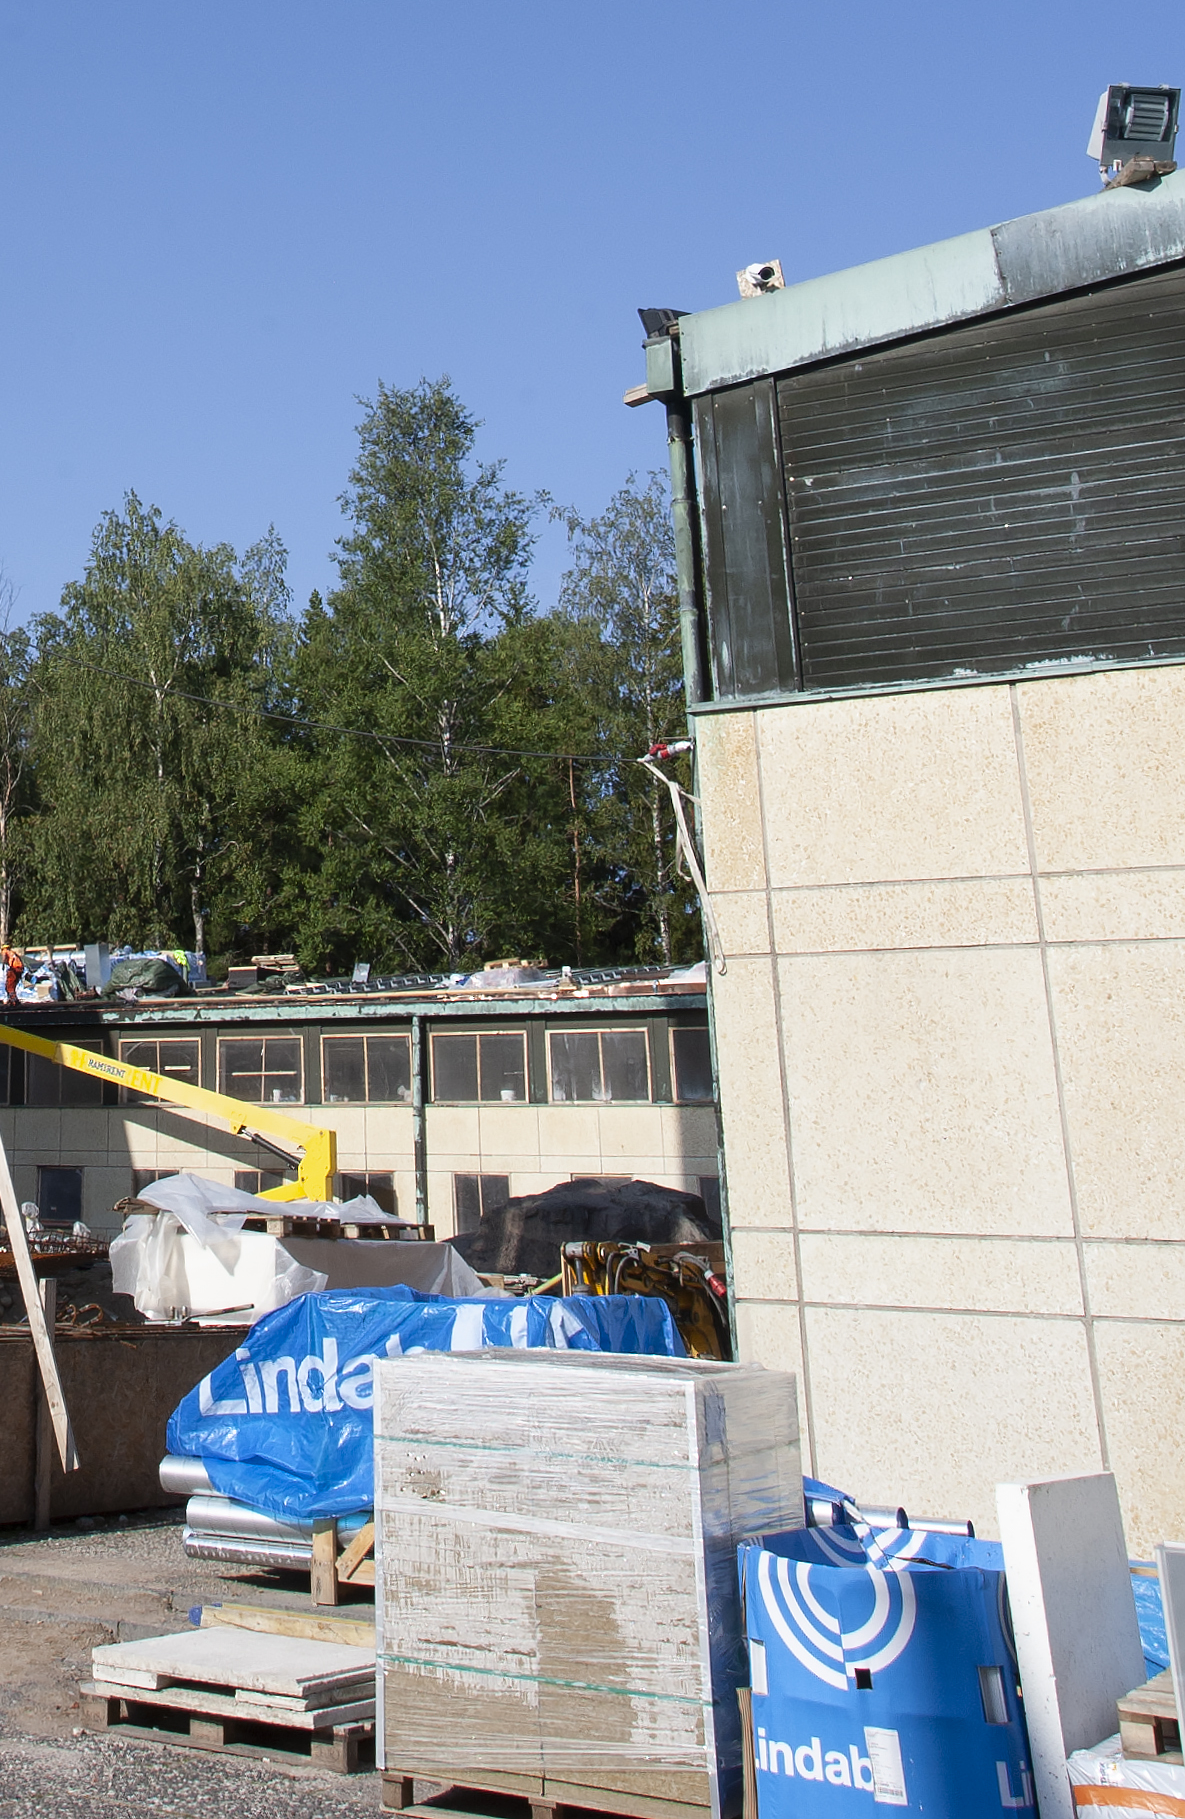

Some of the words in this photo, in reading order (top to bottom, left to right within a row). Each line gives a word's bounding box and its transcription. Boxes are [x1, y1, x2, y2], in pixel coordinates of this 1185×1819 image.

[88, 1058, 126, 1079] RAMIRENT
[199, 1333, 427, 1417] Linda
[755, 1726, 875, 1793] indab
